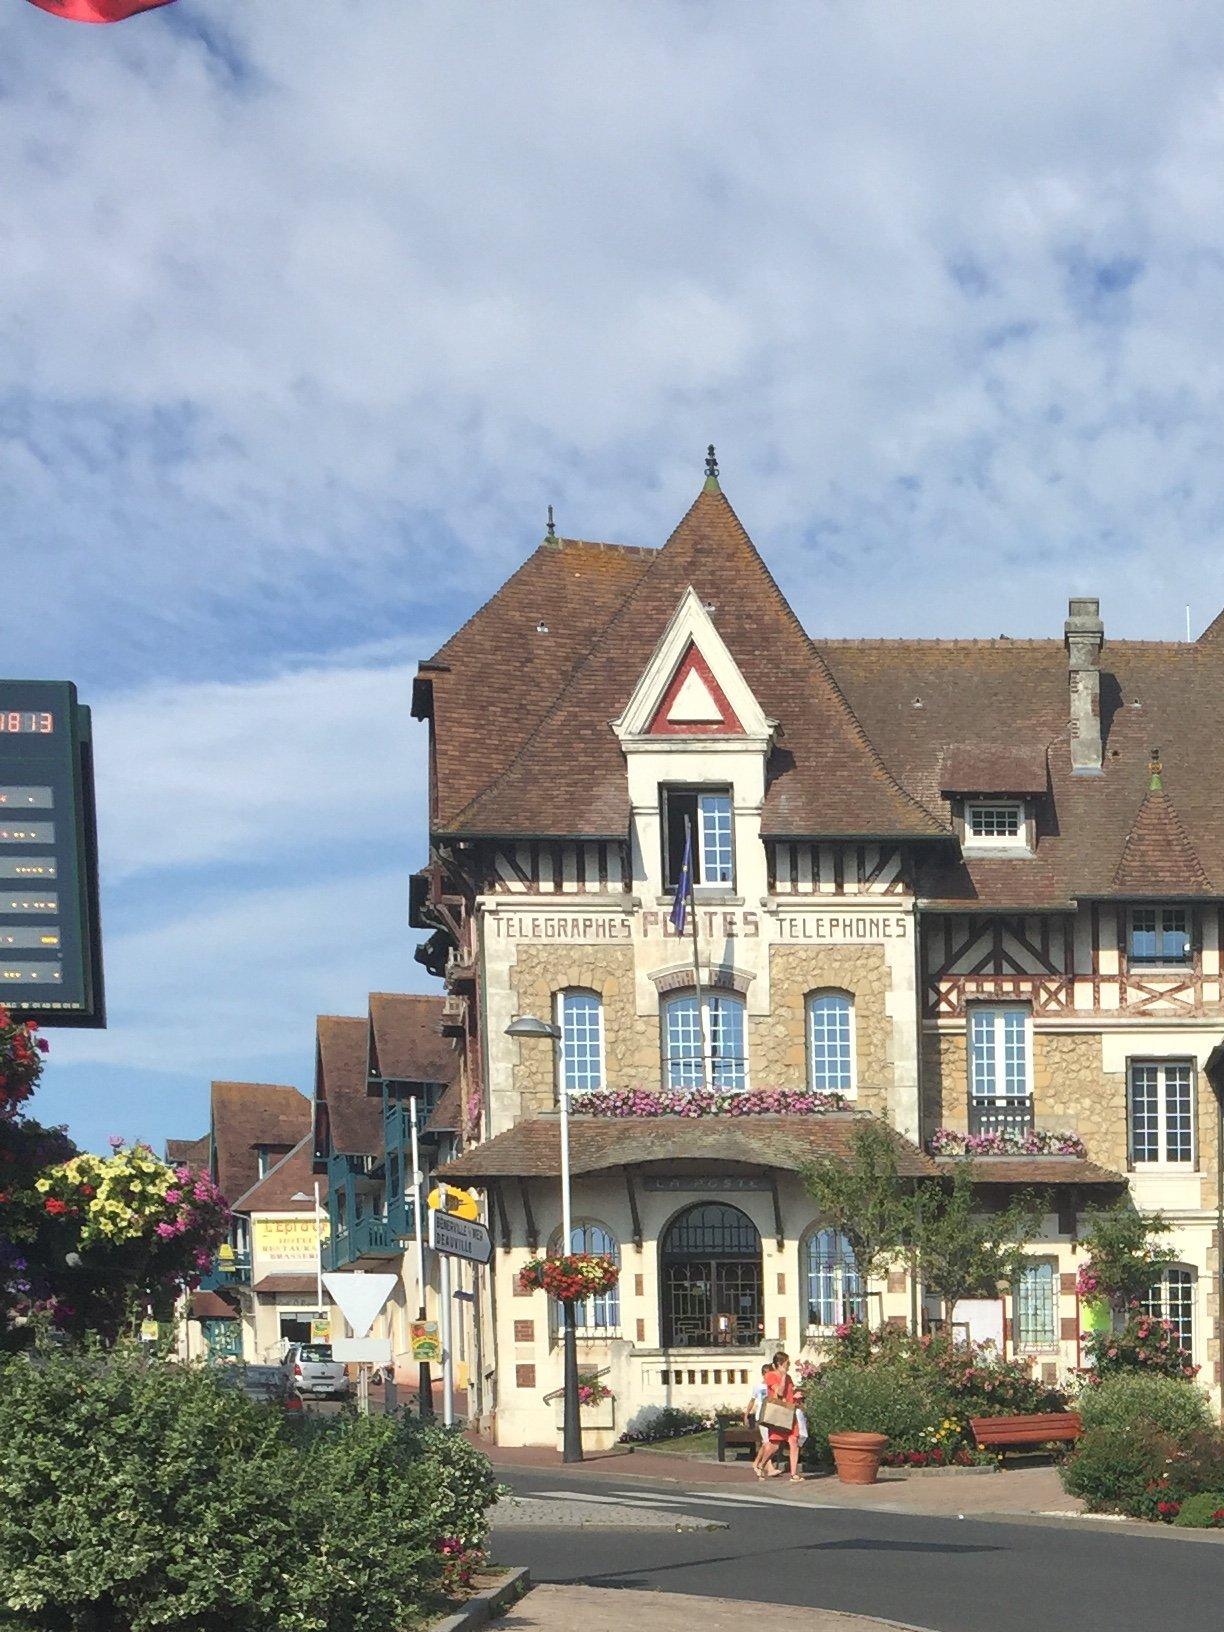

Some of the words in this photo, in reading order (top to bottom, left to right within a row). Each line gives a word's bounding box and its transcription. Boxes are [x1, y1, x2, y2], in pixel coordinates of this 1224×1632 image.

[492, 917, 632, 938] TELEGRAPHES
[642, 911, 759, 938] POSTES
[775, 918, 907, 938] TELEPHONES
